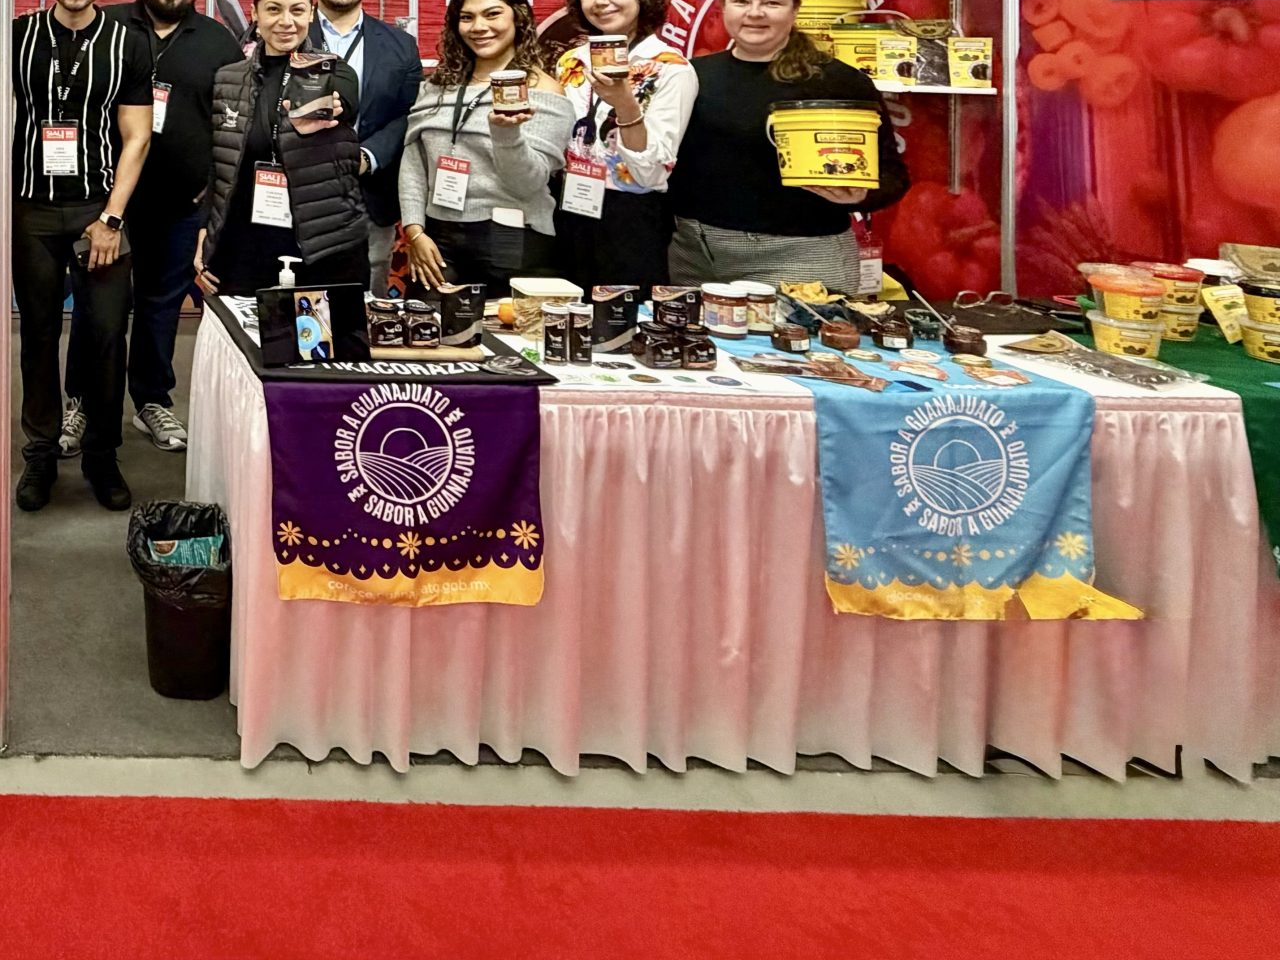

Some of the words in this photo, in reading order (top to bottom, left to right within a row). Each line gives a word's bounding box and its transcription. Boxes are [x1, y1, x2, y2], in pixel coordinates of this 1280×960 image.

[342, 414, 362, 430] A
[350, 382, 451, 418] GUANAJUATO
[904, 393, 1006, 433] GUANAJUATO
[334, 428, 357, 483] SABOR
[897, 429, 915, 443] A
[363, 494, 415, 527] SABOR
[418, 505, 430, 525] A
[428, 427, 476, 520] GUANAJUATO
[890, 441, 913, 498] SABOR
[918, 507, 964, 537] SABOR
[967, 516, 980, 536] A
[979, 440, 1031, 531] GUANAJUATO
